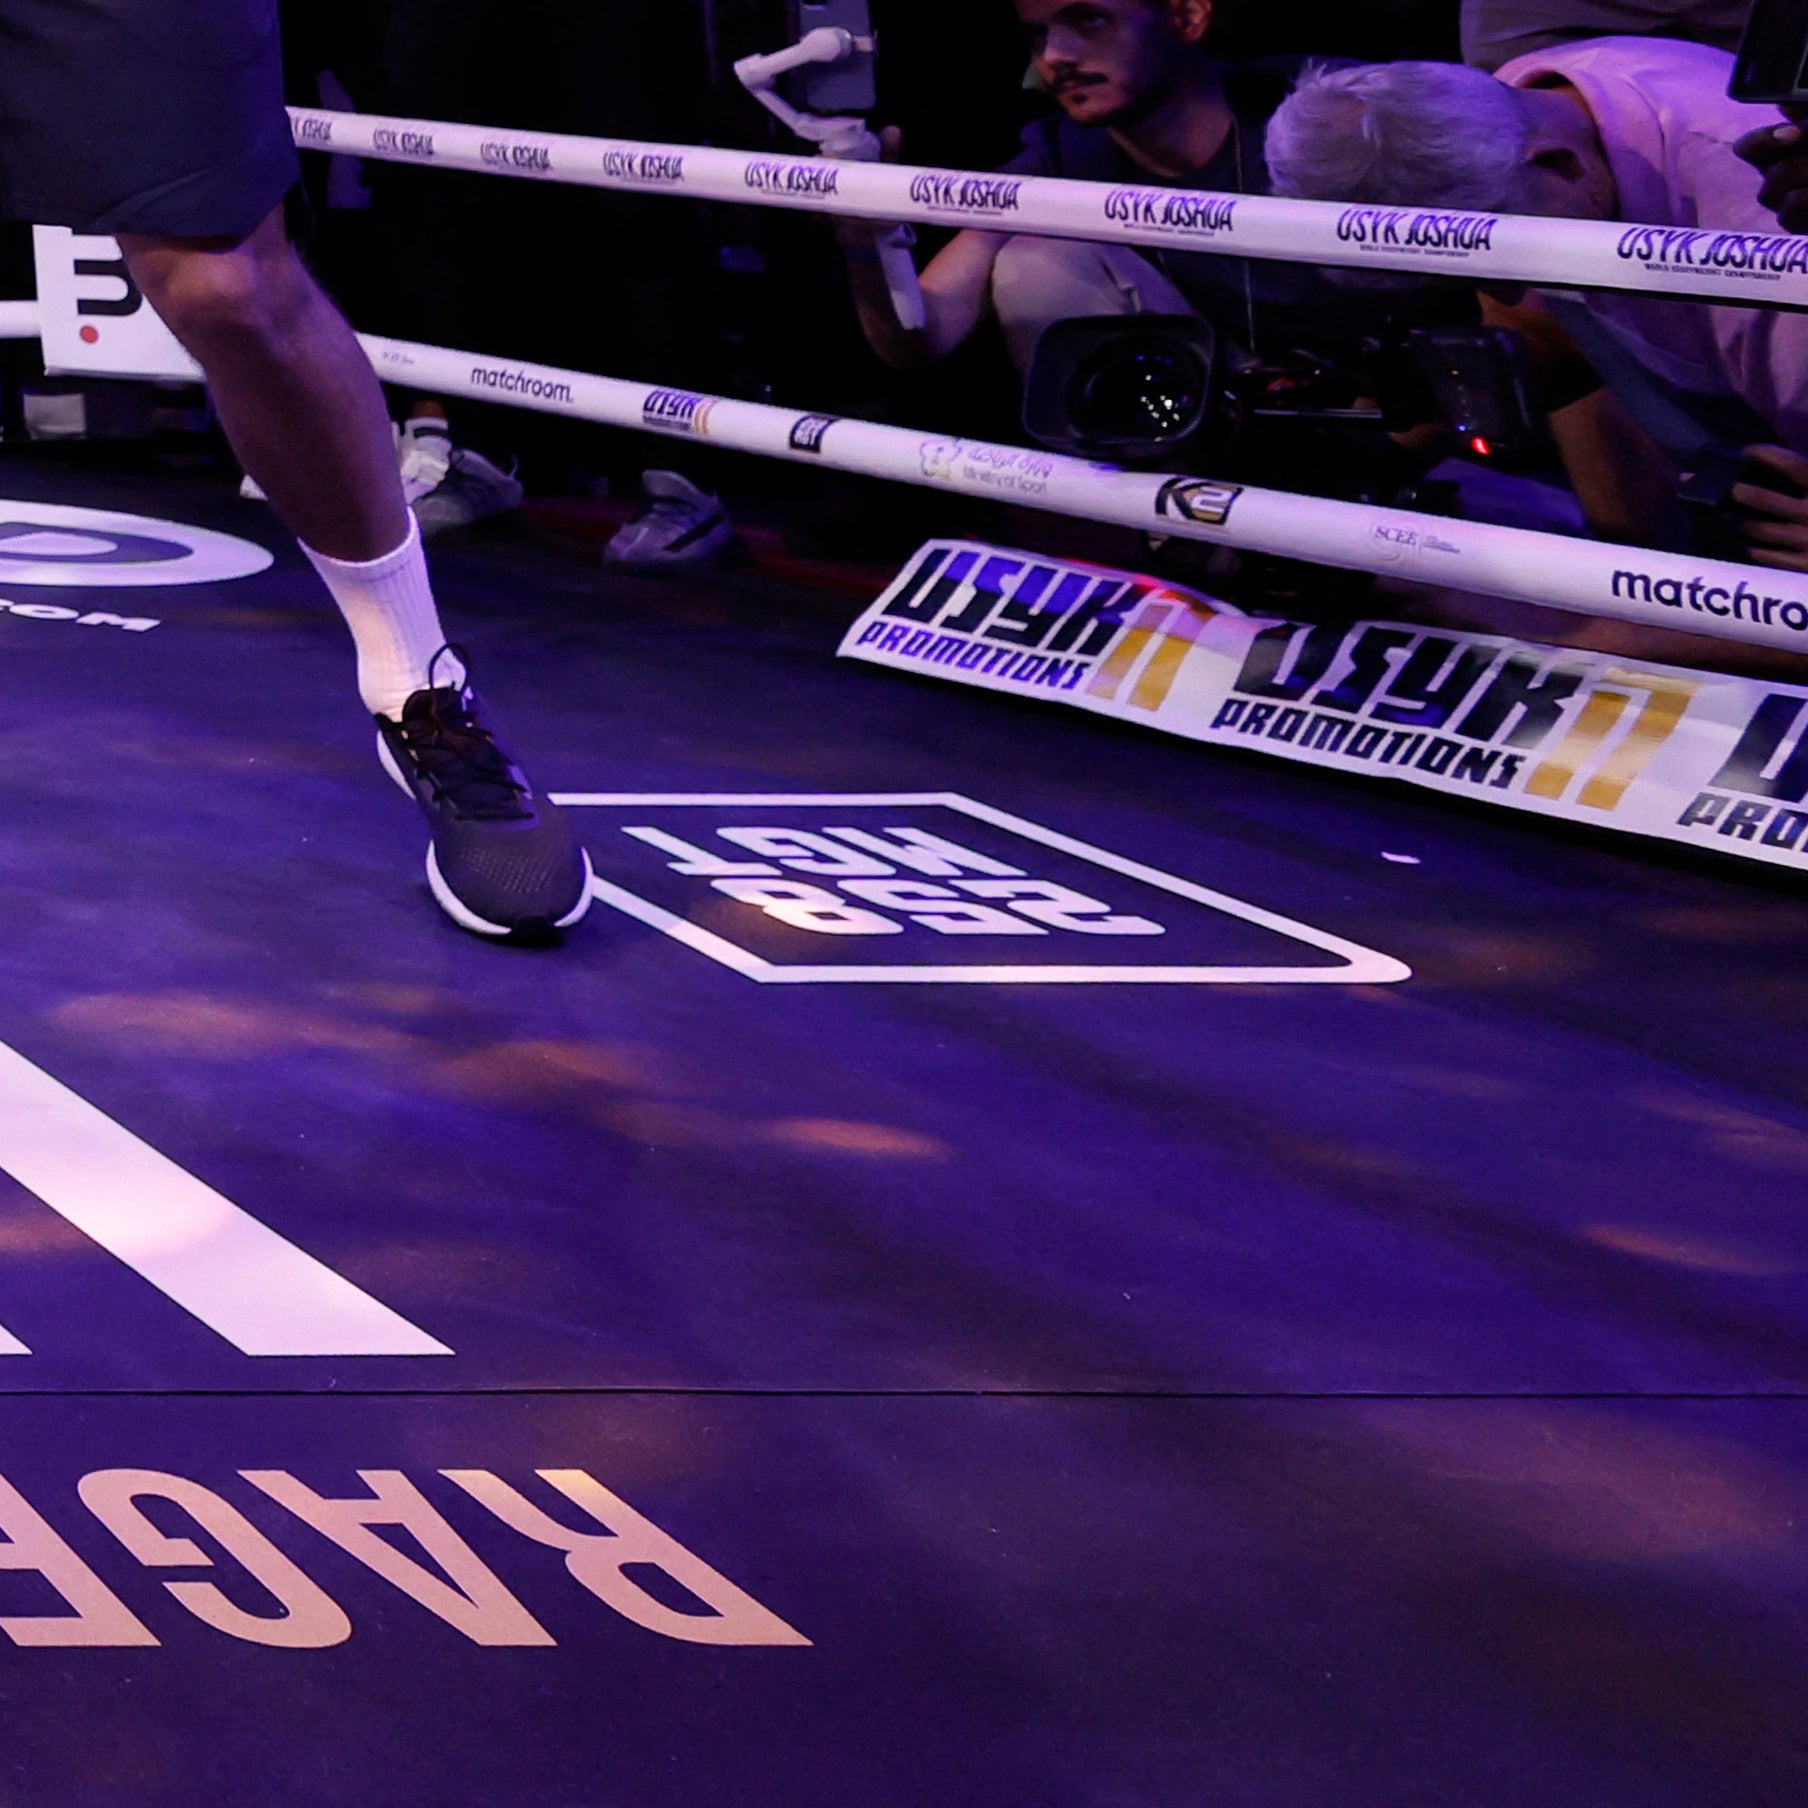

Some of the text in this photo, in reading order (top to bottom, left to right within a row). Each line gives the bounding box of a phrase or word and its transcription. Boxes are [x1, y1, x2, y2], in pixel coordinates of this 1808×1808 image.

[909, 172, 1019, 212] USYK JOSHUA
[1104, 187, 1234, 233] USYK JOSHUA
[1335, 206, 1493, 252] USYK JOSHUA
[1617, 226, 1708, 260] USYK
[1699, 233, 1808, 275] JOSHUA
[471, 366, 575, 404] matchroom.
[1374, 525, 1418, 547] SCEE
[880, 547, 1147, 662] USYK
[856, 618, 1092, 692] PROMOTIONS
[1233, 620, 1599, 752] USYK
[1209, 696, 1528, 792] PROMOTIONS
[620, 825, 1029, 878] MGT
[710, 877, 1168, 936] 258
